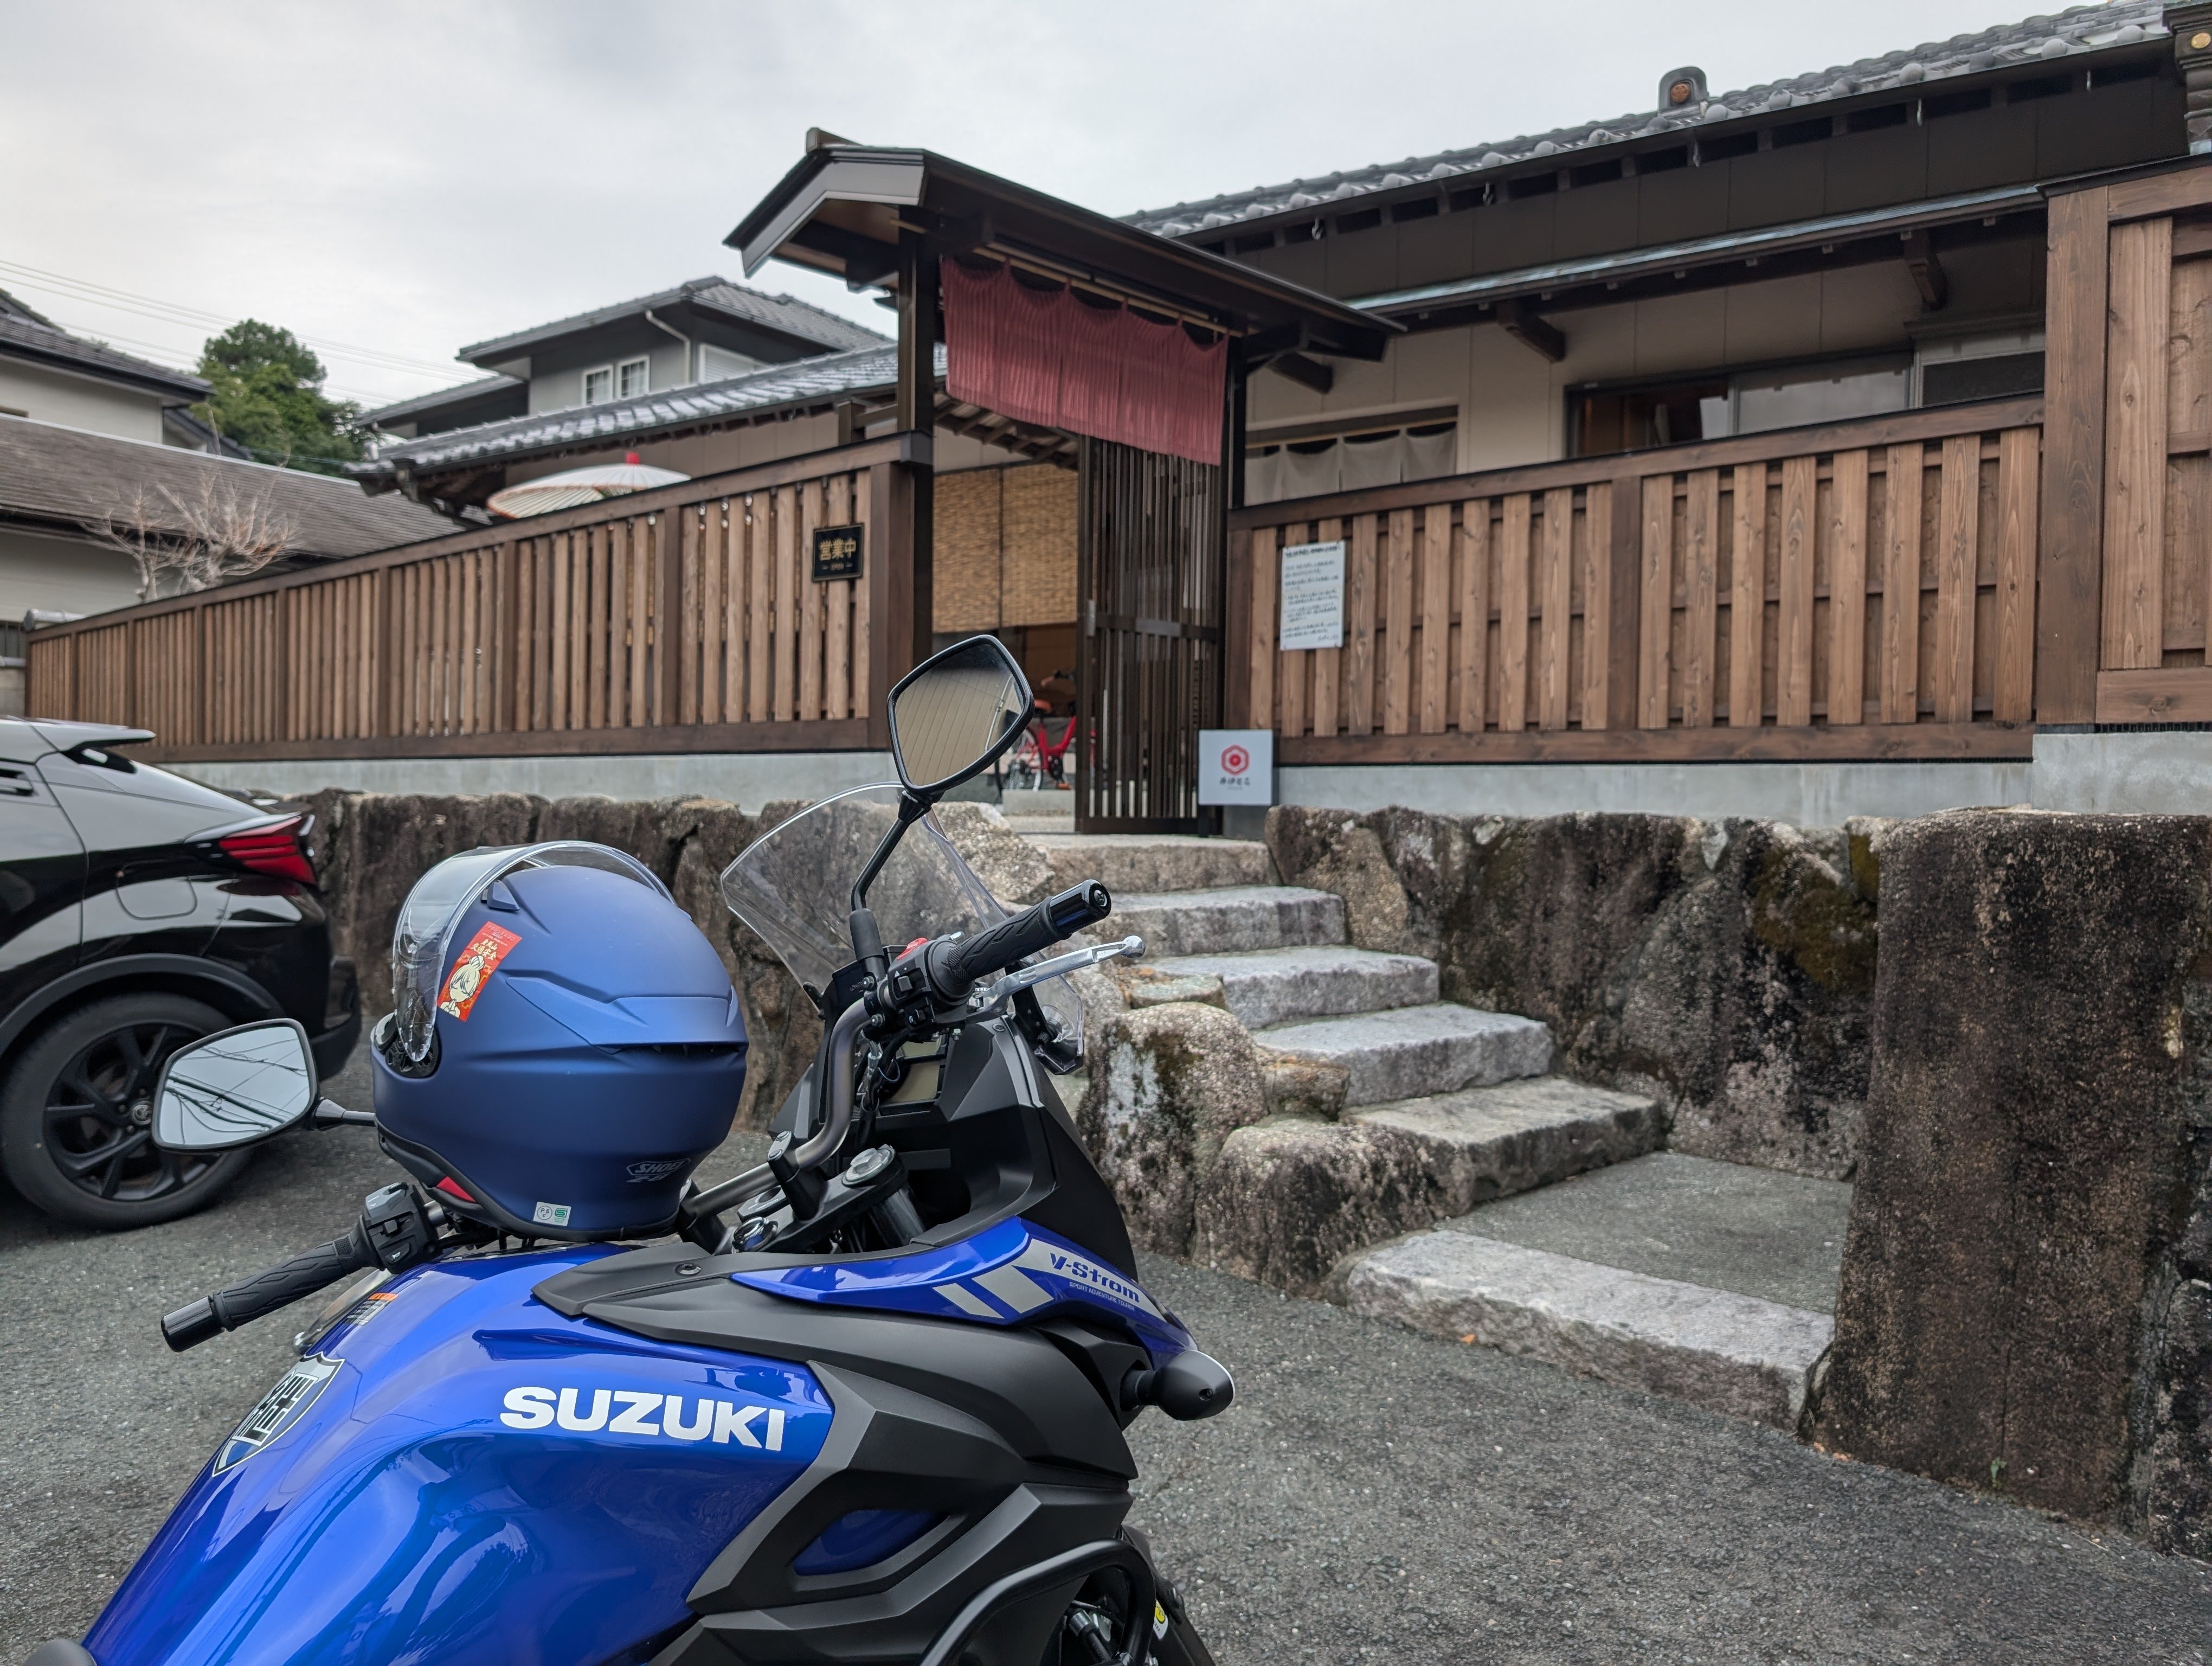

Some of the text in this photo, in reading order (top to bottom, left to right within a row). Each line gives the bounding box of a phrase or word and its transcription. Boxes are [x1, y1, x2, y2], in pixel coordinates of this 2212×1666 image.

[819, 537, 857, 561] 営業中
[471, 943, 498, 960] 交通安全
[635, 1161, 685, 1173] SHOEI
[1050, 1252, 1141, 1303] V-Strom
[1069, 1281, 1135, 1311] SPORT ADVENTURE TOURER
[500, 1386, 785, 1451] SUZUKI
